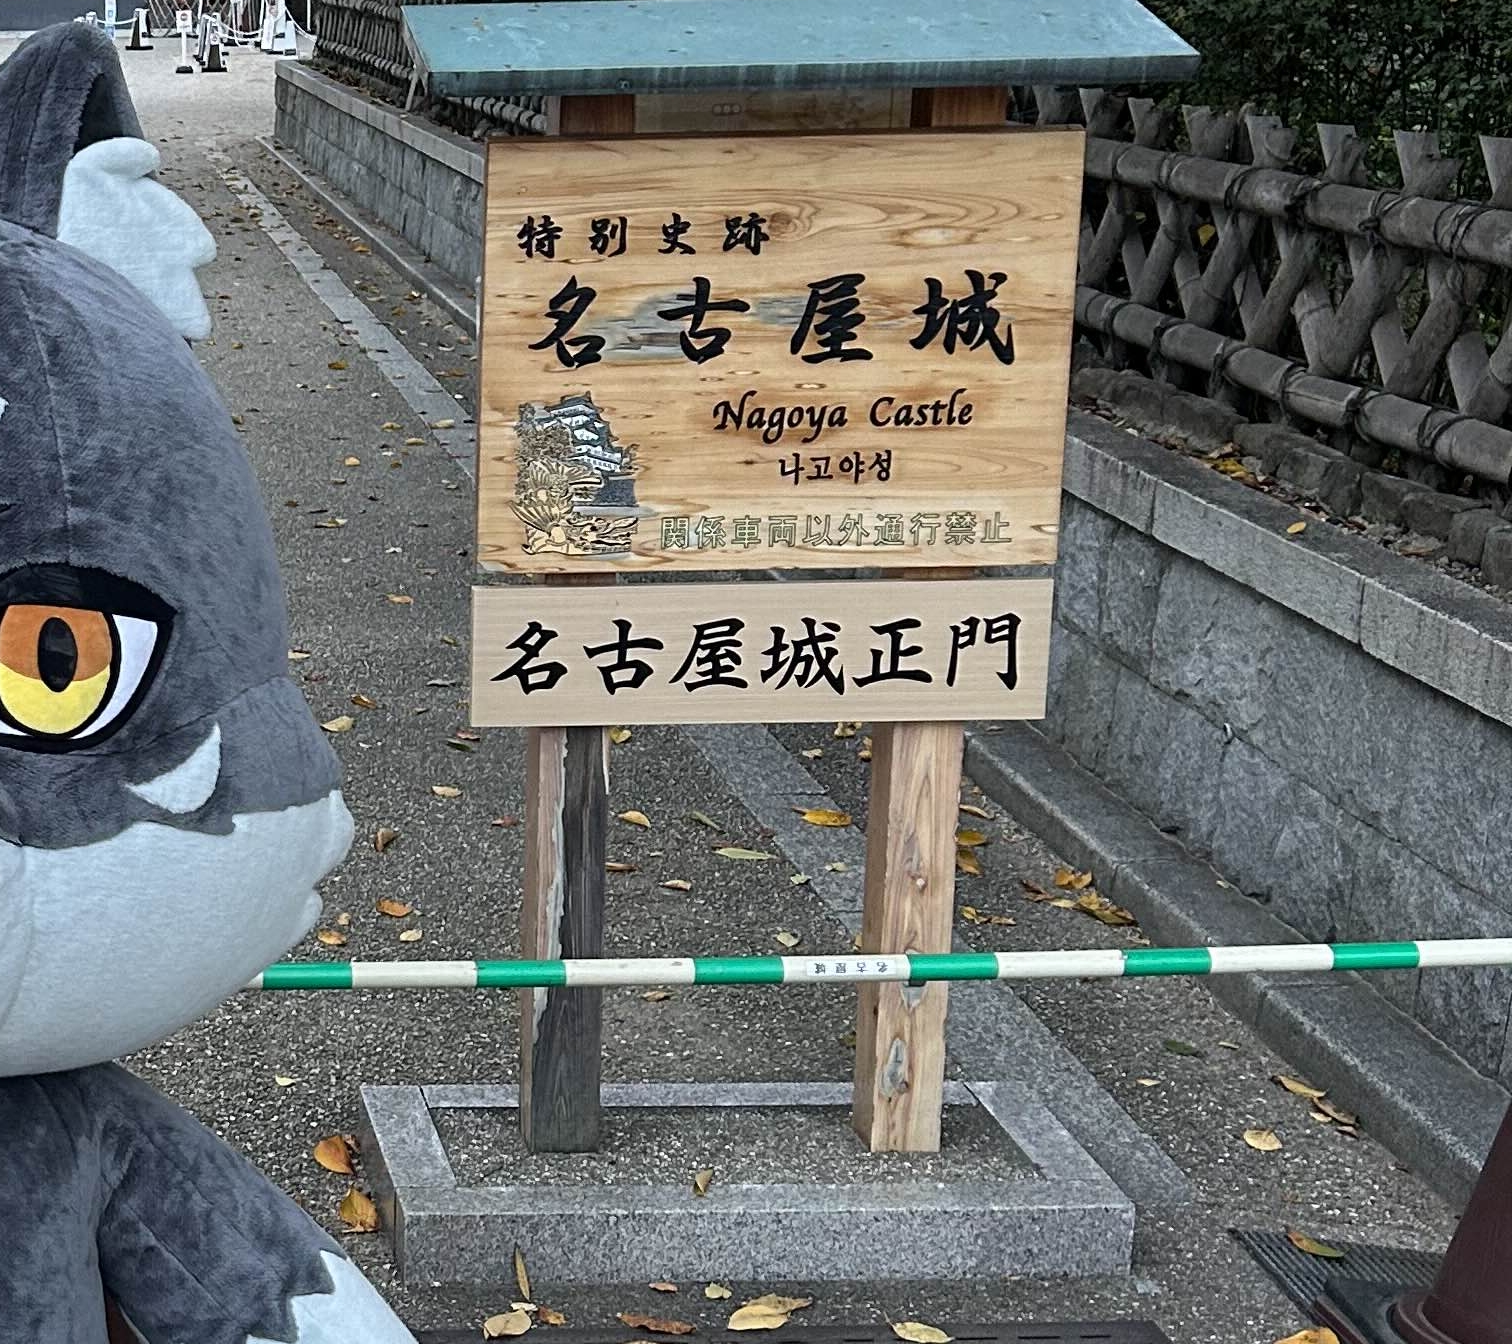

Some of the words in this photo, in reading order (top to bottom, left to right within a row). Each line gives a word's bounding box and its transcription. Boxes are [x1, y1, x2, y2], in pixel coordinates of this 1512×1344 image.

[516, 212, 770, 259] 特別史跡
[528, 269, 1016, 367] 名古屋城
[713, 390, 848, 445] Nagoya
[869, 388, 974, 428] Castle
[778, 450, 893, 486] 나고야성
[660, 511, 1013, 550] 関係車両以外通行禁止
[490, 611, 1023, 696] 名古屋城正門
